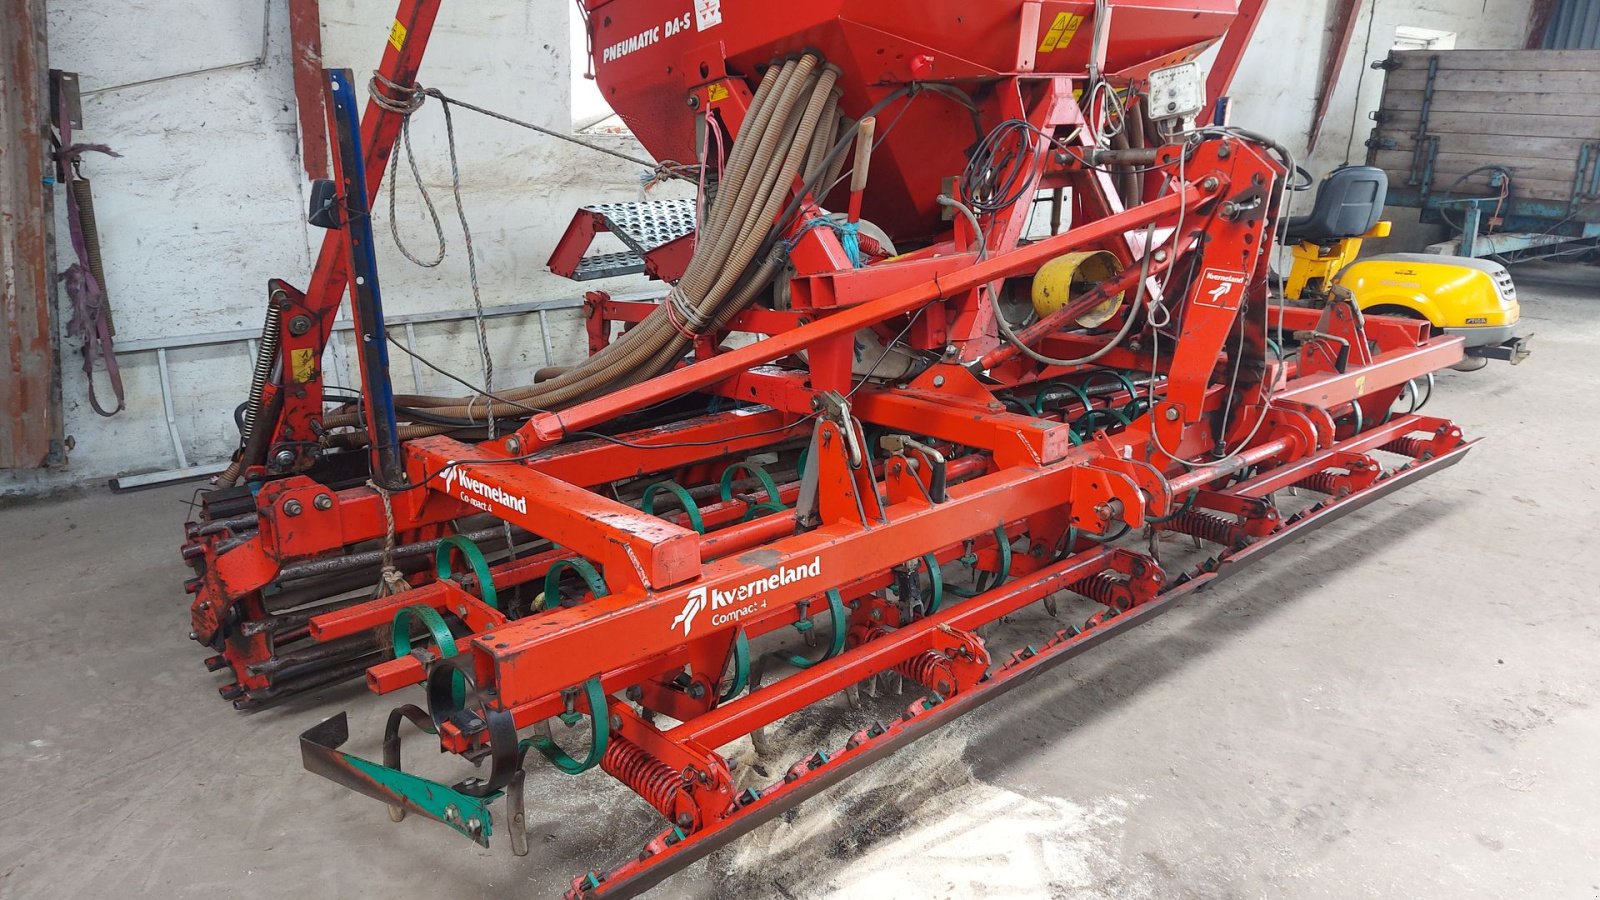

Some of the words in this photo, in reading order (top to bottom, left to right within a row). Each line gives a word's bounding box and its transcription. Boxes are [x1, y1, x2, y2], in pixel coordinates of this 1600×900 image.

[603, 26, 660, 63] PNEUMATIC
[664, 12, 691, 38] DA-S
[458, 468, 527, 515] Kverneland
[711, 556, 821, 610] Kverneland
